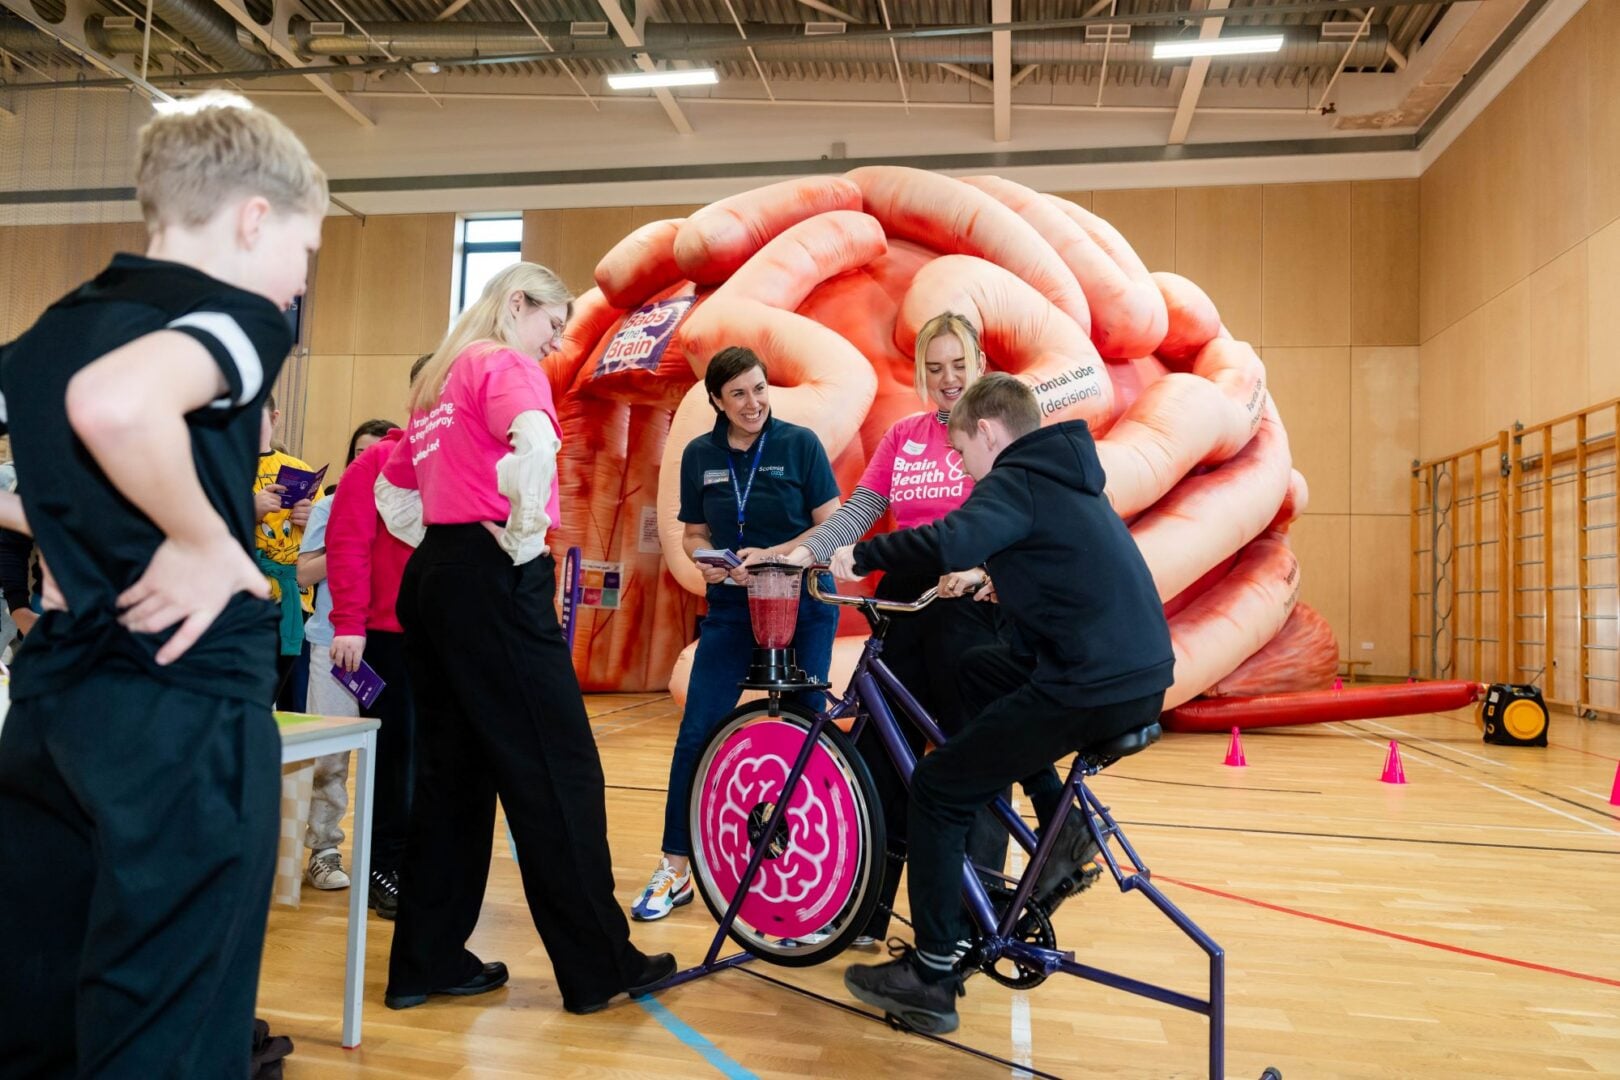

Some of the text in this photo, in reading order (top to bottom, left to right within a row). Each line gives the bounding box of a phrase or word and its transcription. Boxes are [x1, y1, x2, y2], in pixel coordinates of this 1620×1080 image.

[625, 309, 668, 329] Babs
[624, 329, 641, 340] the
[606, 336, 653, 359] Brain
[1031, 365, 1096, 395] rontal lobe
[1040, 381, 1102, 418] (decisions)
[893, 456, 938, 473] Brain
[891, 468, 945, 487] Health
[889, 482, 963, 503] Scotland
